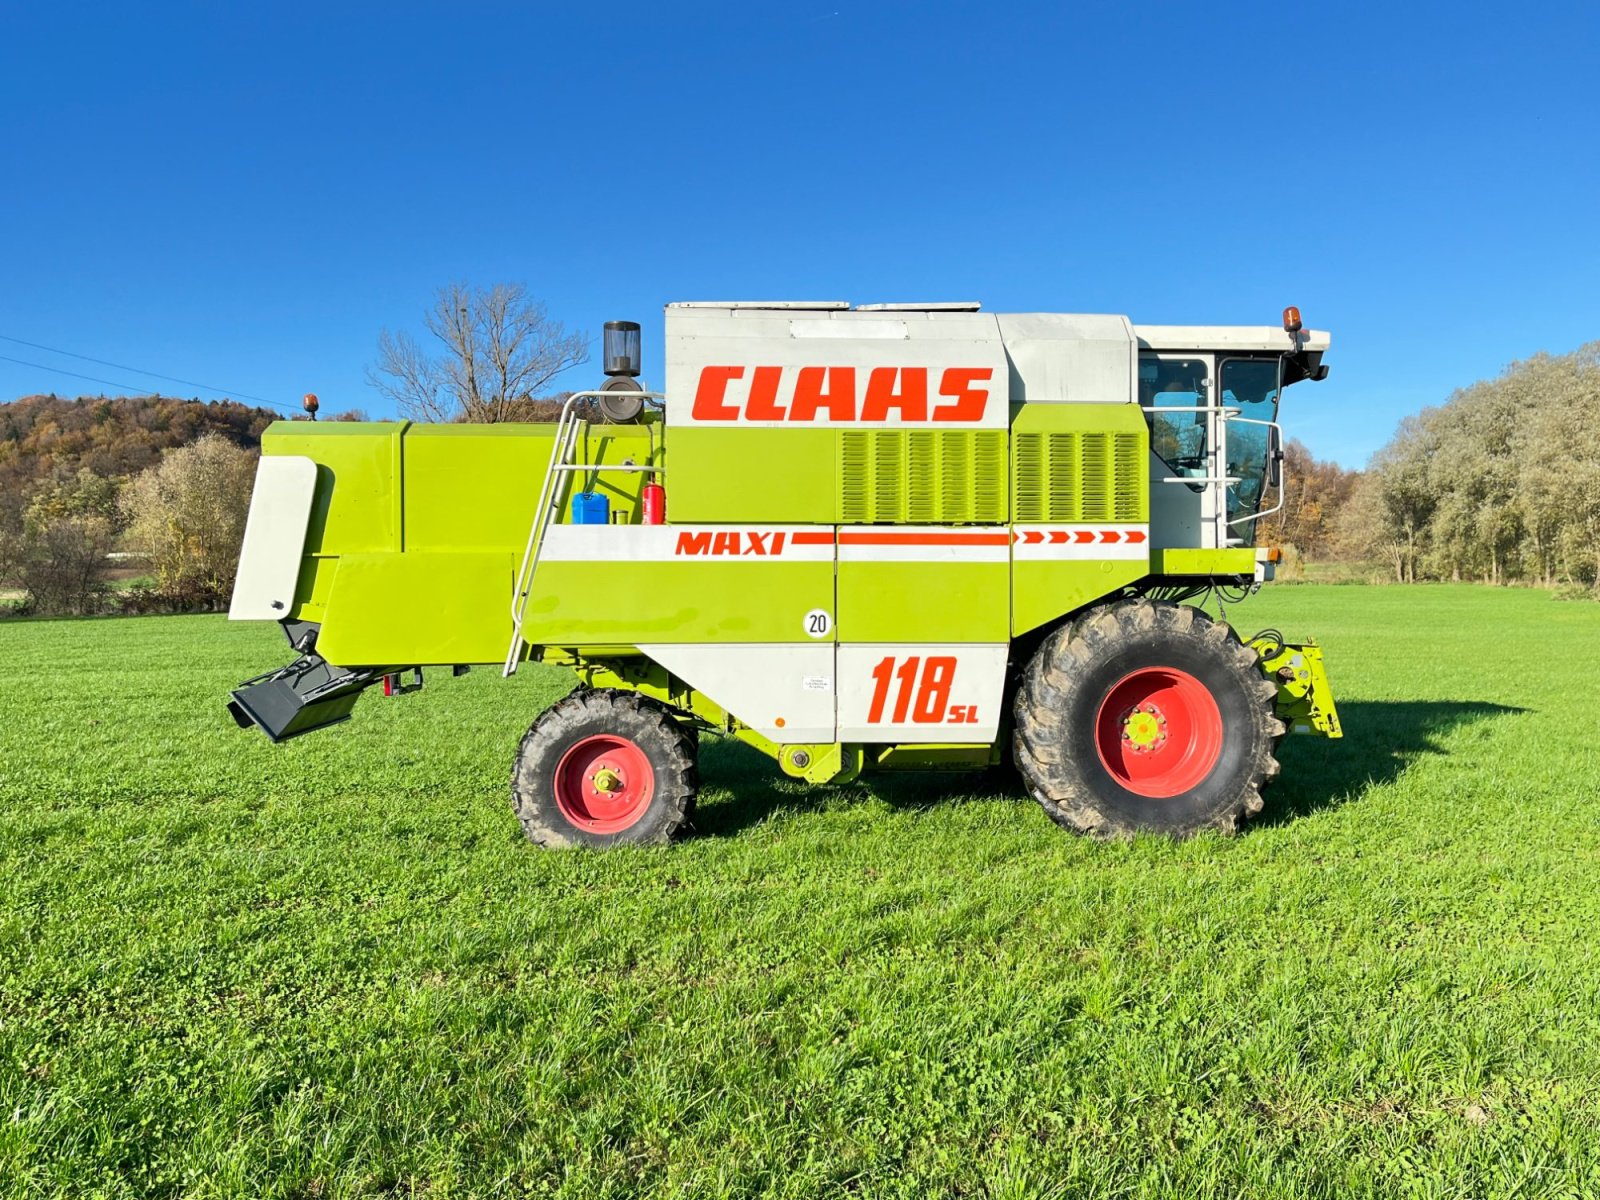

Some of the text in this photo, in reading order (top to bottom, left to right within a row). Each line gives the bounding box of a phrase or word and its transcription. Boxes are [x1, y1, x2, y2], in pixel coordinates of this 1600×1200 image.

[692, 366, 992, 421] CLAAS
[675, 532, 786, 556] MAXI
[809, 614, 826, 633] 20
[867, 656, 979, 724] 118 SL
